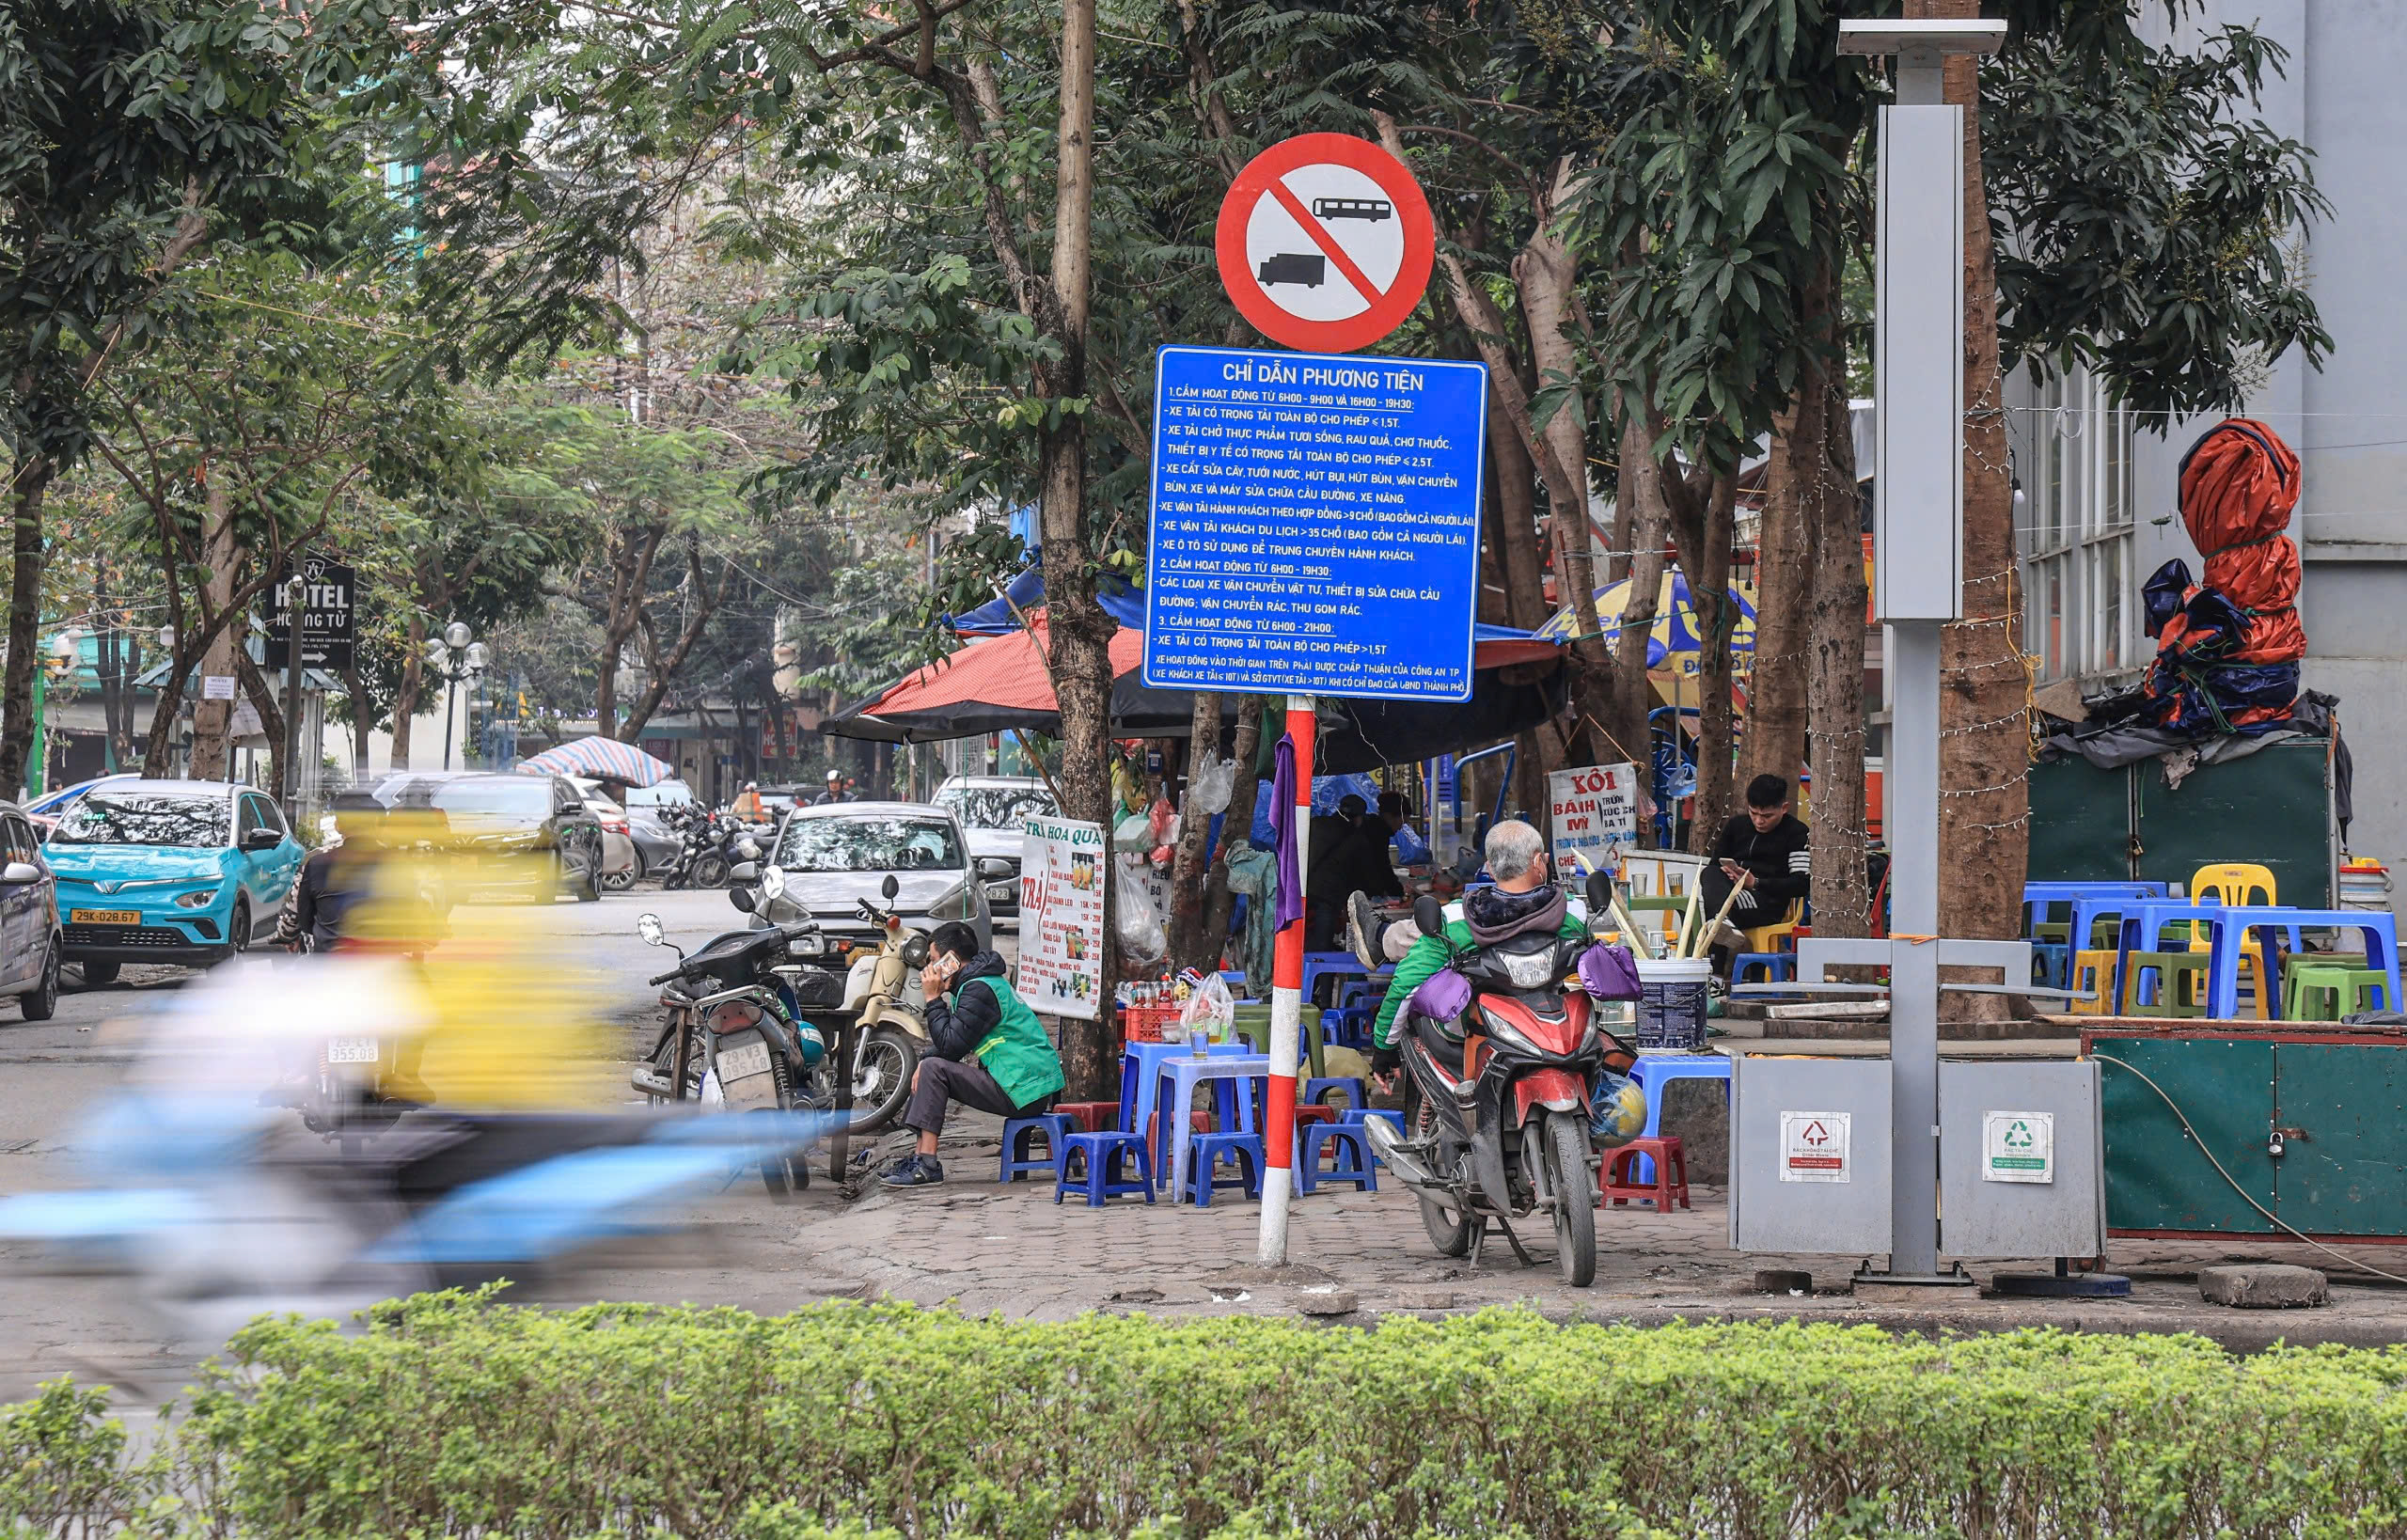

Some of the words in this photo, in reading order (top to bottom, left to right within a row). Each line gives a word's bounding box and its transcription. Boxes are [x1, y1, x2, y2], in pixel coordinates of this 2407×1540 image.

[1222, 357, 1253, 381] CHỈ
[1257, 359, 1297, 384] DẪN
[1302, 367, 1378, 388] PHƯƠNG
[1383, 369, 1423, 393] TIỆN
[1202, 388, 1228, 400] HOẠT
[1231, 387, 1258, 401] ĐỘNG
[1261, 389, 1275, 401] TỪ
[1278, 392, 1301, 402] 6H00
[1309, 394, 1333, 404] 9H00
[1335, 393, 1347, 405] VÀ
[1349, 396, 1377, 407] 16H00
[1186, 403, 1200, 416] TẢI
[1203, 405, 1217, 417] CÓ
[1219, 408, 1253, 421] TRỌNG
[1256, 407, 1271, 420] TẢI
[1274, 409, 1300, 422] TOÀN
[1303, 411, 1317, 425] BỘ
[1319, 414, 1340, 424] CHO
[1343, 413, 1370, 426] PHÉP
[1183, 422, 1198, 435] TẢI
[1201, 423, 1222, 437] CHỞ
[1224, 427, 1251, 440] THỰC
[1255, 424, 1285, 440] PHẨM
[1288, 431, 1312, 442] TƯƠI
[1345, 433, 1366, 445] RAU
[1167, 440, 1195, 454] THIẾT
[1198, 445, 1208, 457] BỊ
[1210, 446, 1217, 455] Y
[1219, 442, 1232, 457] TẾ
[1234, 445, 1249, 457] CÓ
[1251, 448, 1283, 460] TRỌNG
[1286, 447, 1301, 460] TẢI
[1305, 448, 1331, 462] TOÀN
[1334, 450, 1349, 464] BỘ
[1351, 453, 1372, 464] CHO
[1375, 452, 1401, 465] PHÉP
[1189, 483, 1204, 494] XE
[1205, 481, 1218, 494] VÀ
[1219, 482, 1241, 495] MÁY
[1245, 482, 1265, 496] SỬA
[1266, 485, 1294, 498] CHỮA
[1297, 484, 1317, 499] CẦU
[1360, 492, 1373, 502] XE
[1179, 519, 1199, 532] VẬN
[1203, 519, 1217, 532] TẢI
[1219, 522, 1254, 534] KHÁCH
[1258, 525, 1272, 535] DU
[1275, 526, 1298, 537] LỊCH
[1320, 525, 1342, 538] CHỖ
[1371, 526, 1393, 541] GỒM
[1396, 528, 1410, 542] CẢ
[1412, 530, 1443, 543] NGƯỜI
[1176, 538, 1185, 550] Ô
[1187, 538, 1200, 550] TÔ
[1203, 538, 1218, 551] SỬ
[1219, 542, 1248, 555] DỤNG
[1251, 538, 1266, 554] ĐỂ
[1267, 544, 1301, 556] TRUNG
[1347, 545, 1376, 559] HÀNH
[275, 584, 349, 608] HTEL
[1182, 578, 1204, 590] LOẠI
[1206, 579, 1220, 589] XE
[1223, 578, 1243, 591] VẬN
[1287, 581, 1304, 595] VẬT
[1325, 581, 1352, 596] THIẾT
[1354, 586, 1364, 598] BỊ
[1367, 584, 1387, 597] SỬA
[1390, 587, 1416, 599] CHỮA
[1420, 586, 1439, 600] CẦU
[1047, 825, 1069, 841] HOA
